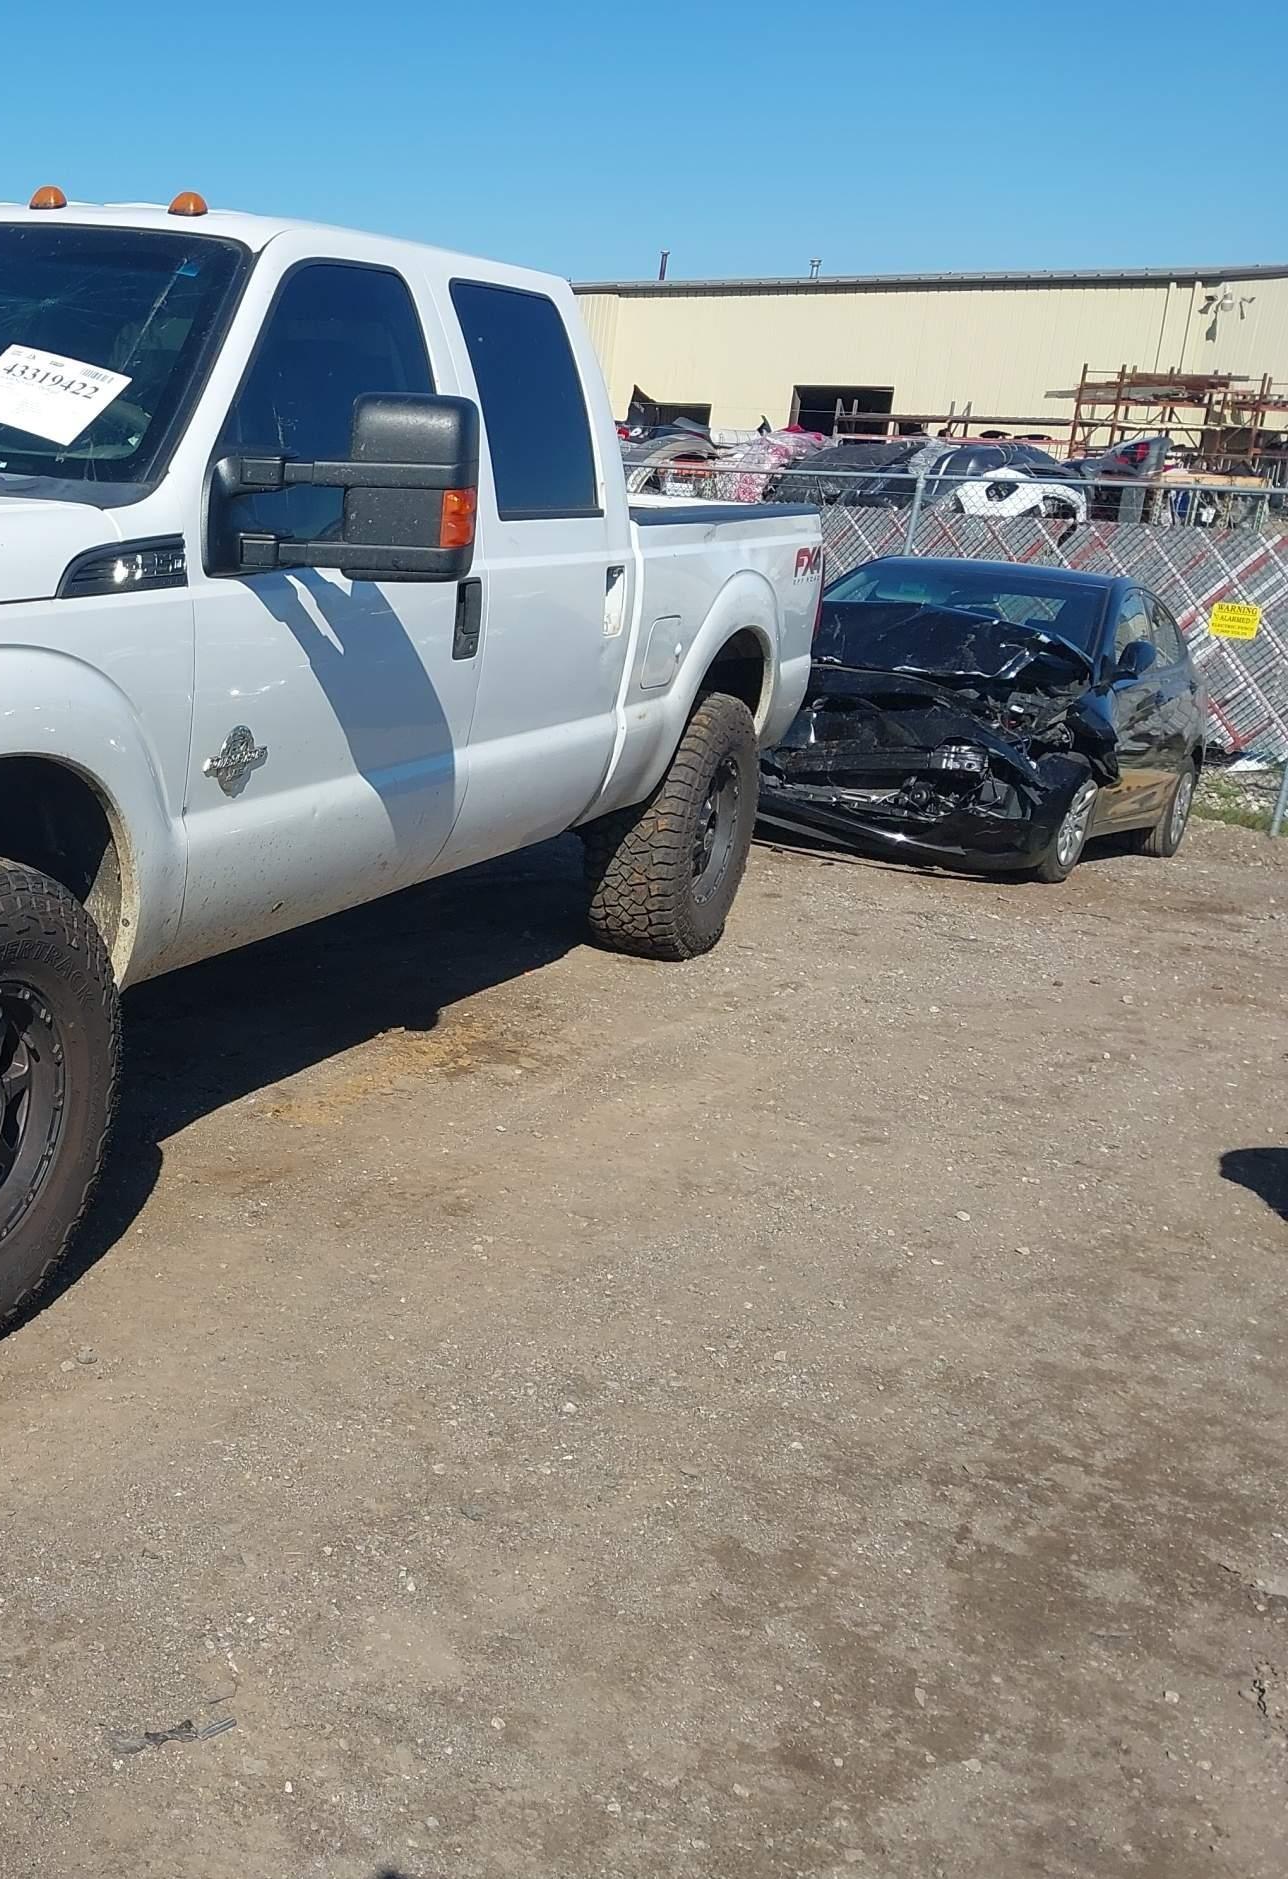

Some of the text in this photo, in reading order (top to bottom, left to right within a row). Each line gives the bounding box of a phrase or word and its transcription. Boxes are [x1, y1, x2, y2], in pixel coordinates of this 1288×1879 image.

[3, 363, 99, 399] 43319422
[794, 546, 821, 578] FX4
[1218, 604, 1258, 614] WARNING
